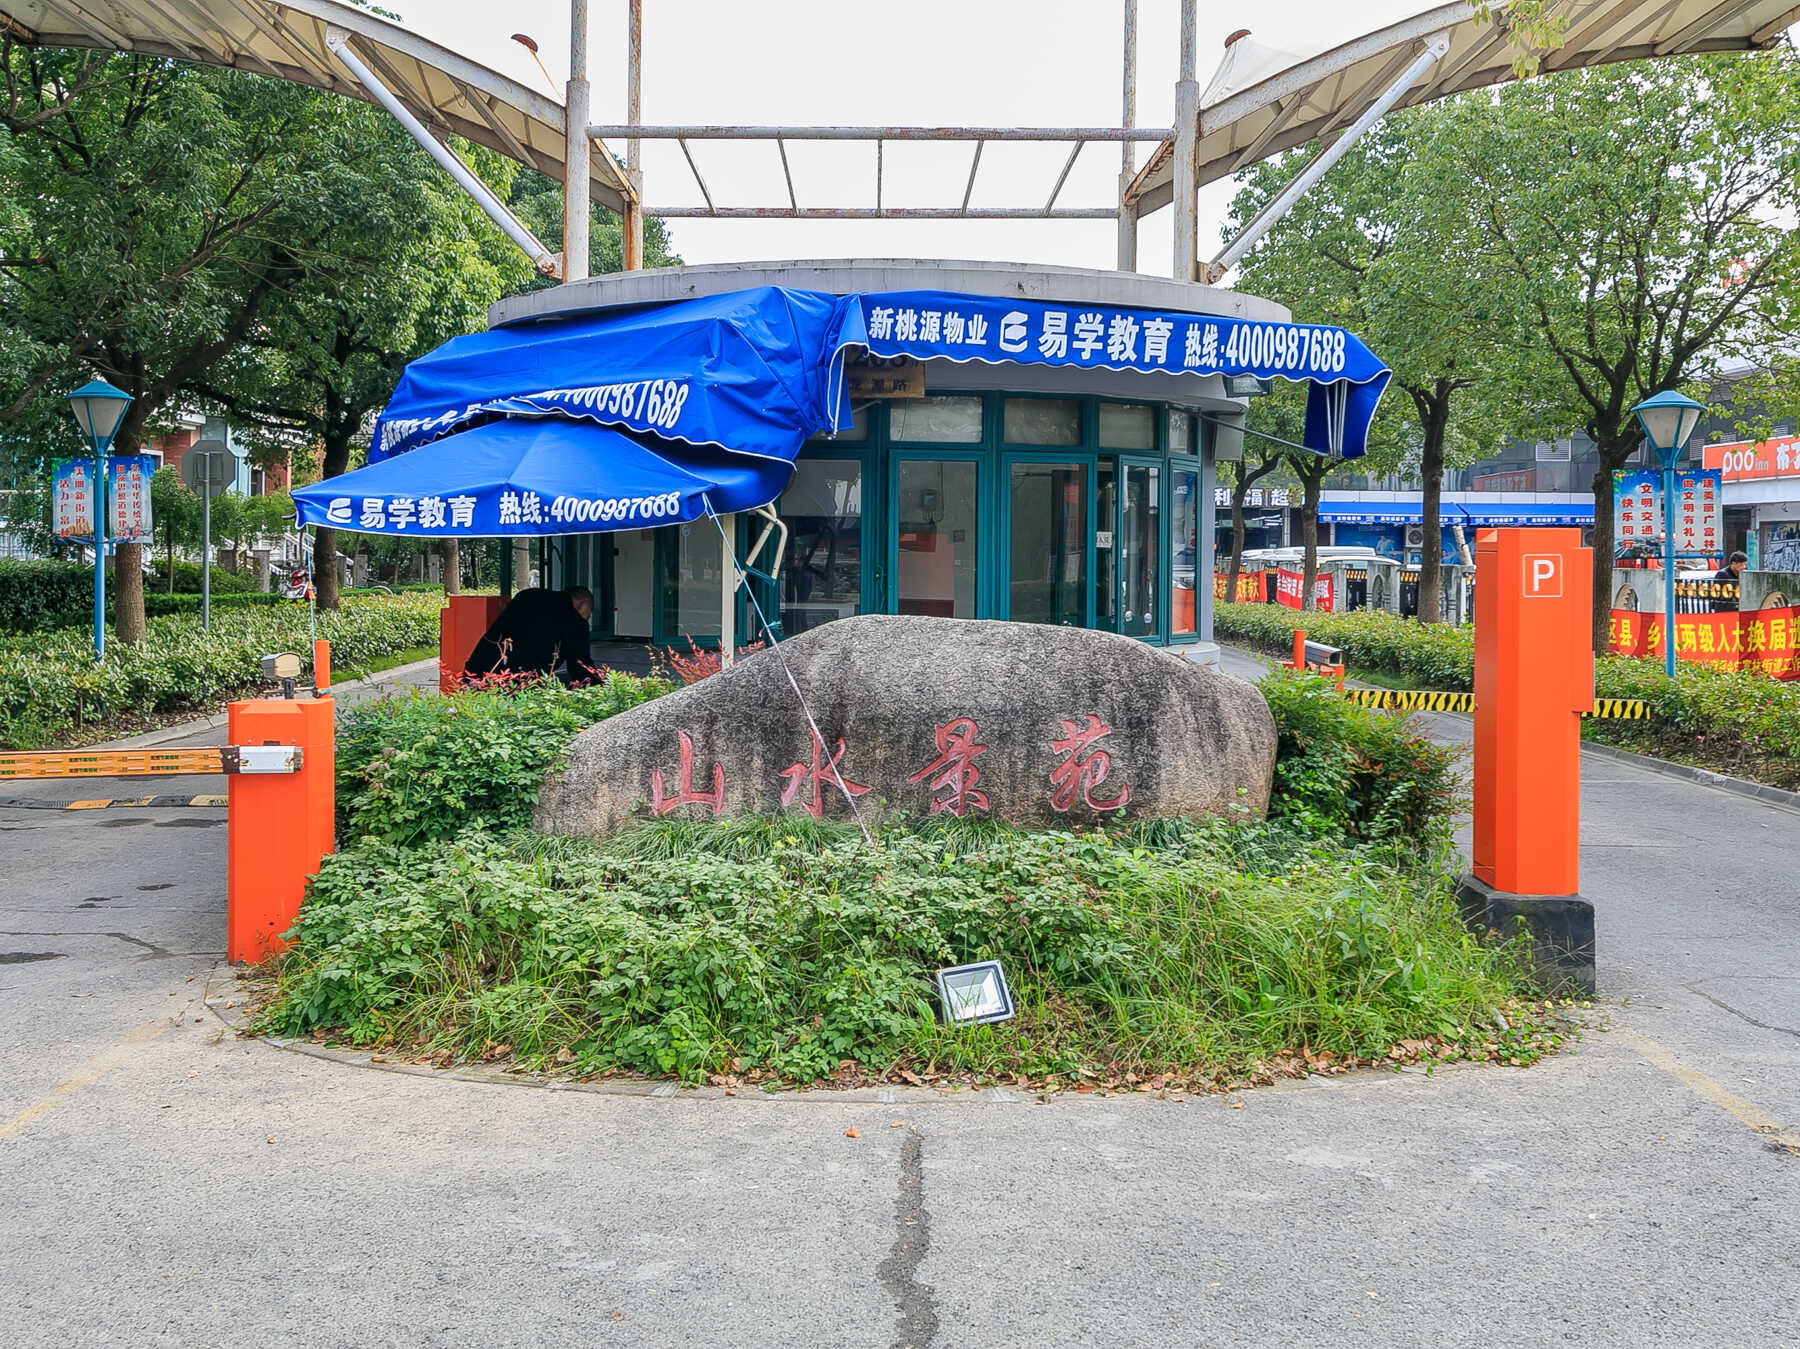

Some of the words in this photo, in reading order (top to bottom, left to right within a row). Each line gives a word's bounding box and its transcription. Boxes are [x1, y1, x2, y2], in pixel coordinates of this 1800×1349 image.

[869, 306, 988, 345] 新桃源物业
[1038, 310, 1174, 365] 易学教育
[360, 494, 477, 530] 易学教育
[1621, 498, 1634, 549] 快乐同行
[1640, 483, 1653, 534] 文明交通
[1682, 479, 1695, 548] 做文明有礼人
[1702, 479, 1715, 548] 建美丽广富林
[1533, 559, 1555, 592] P
[651, 713, 1132, 818] 山水景苑
